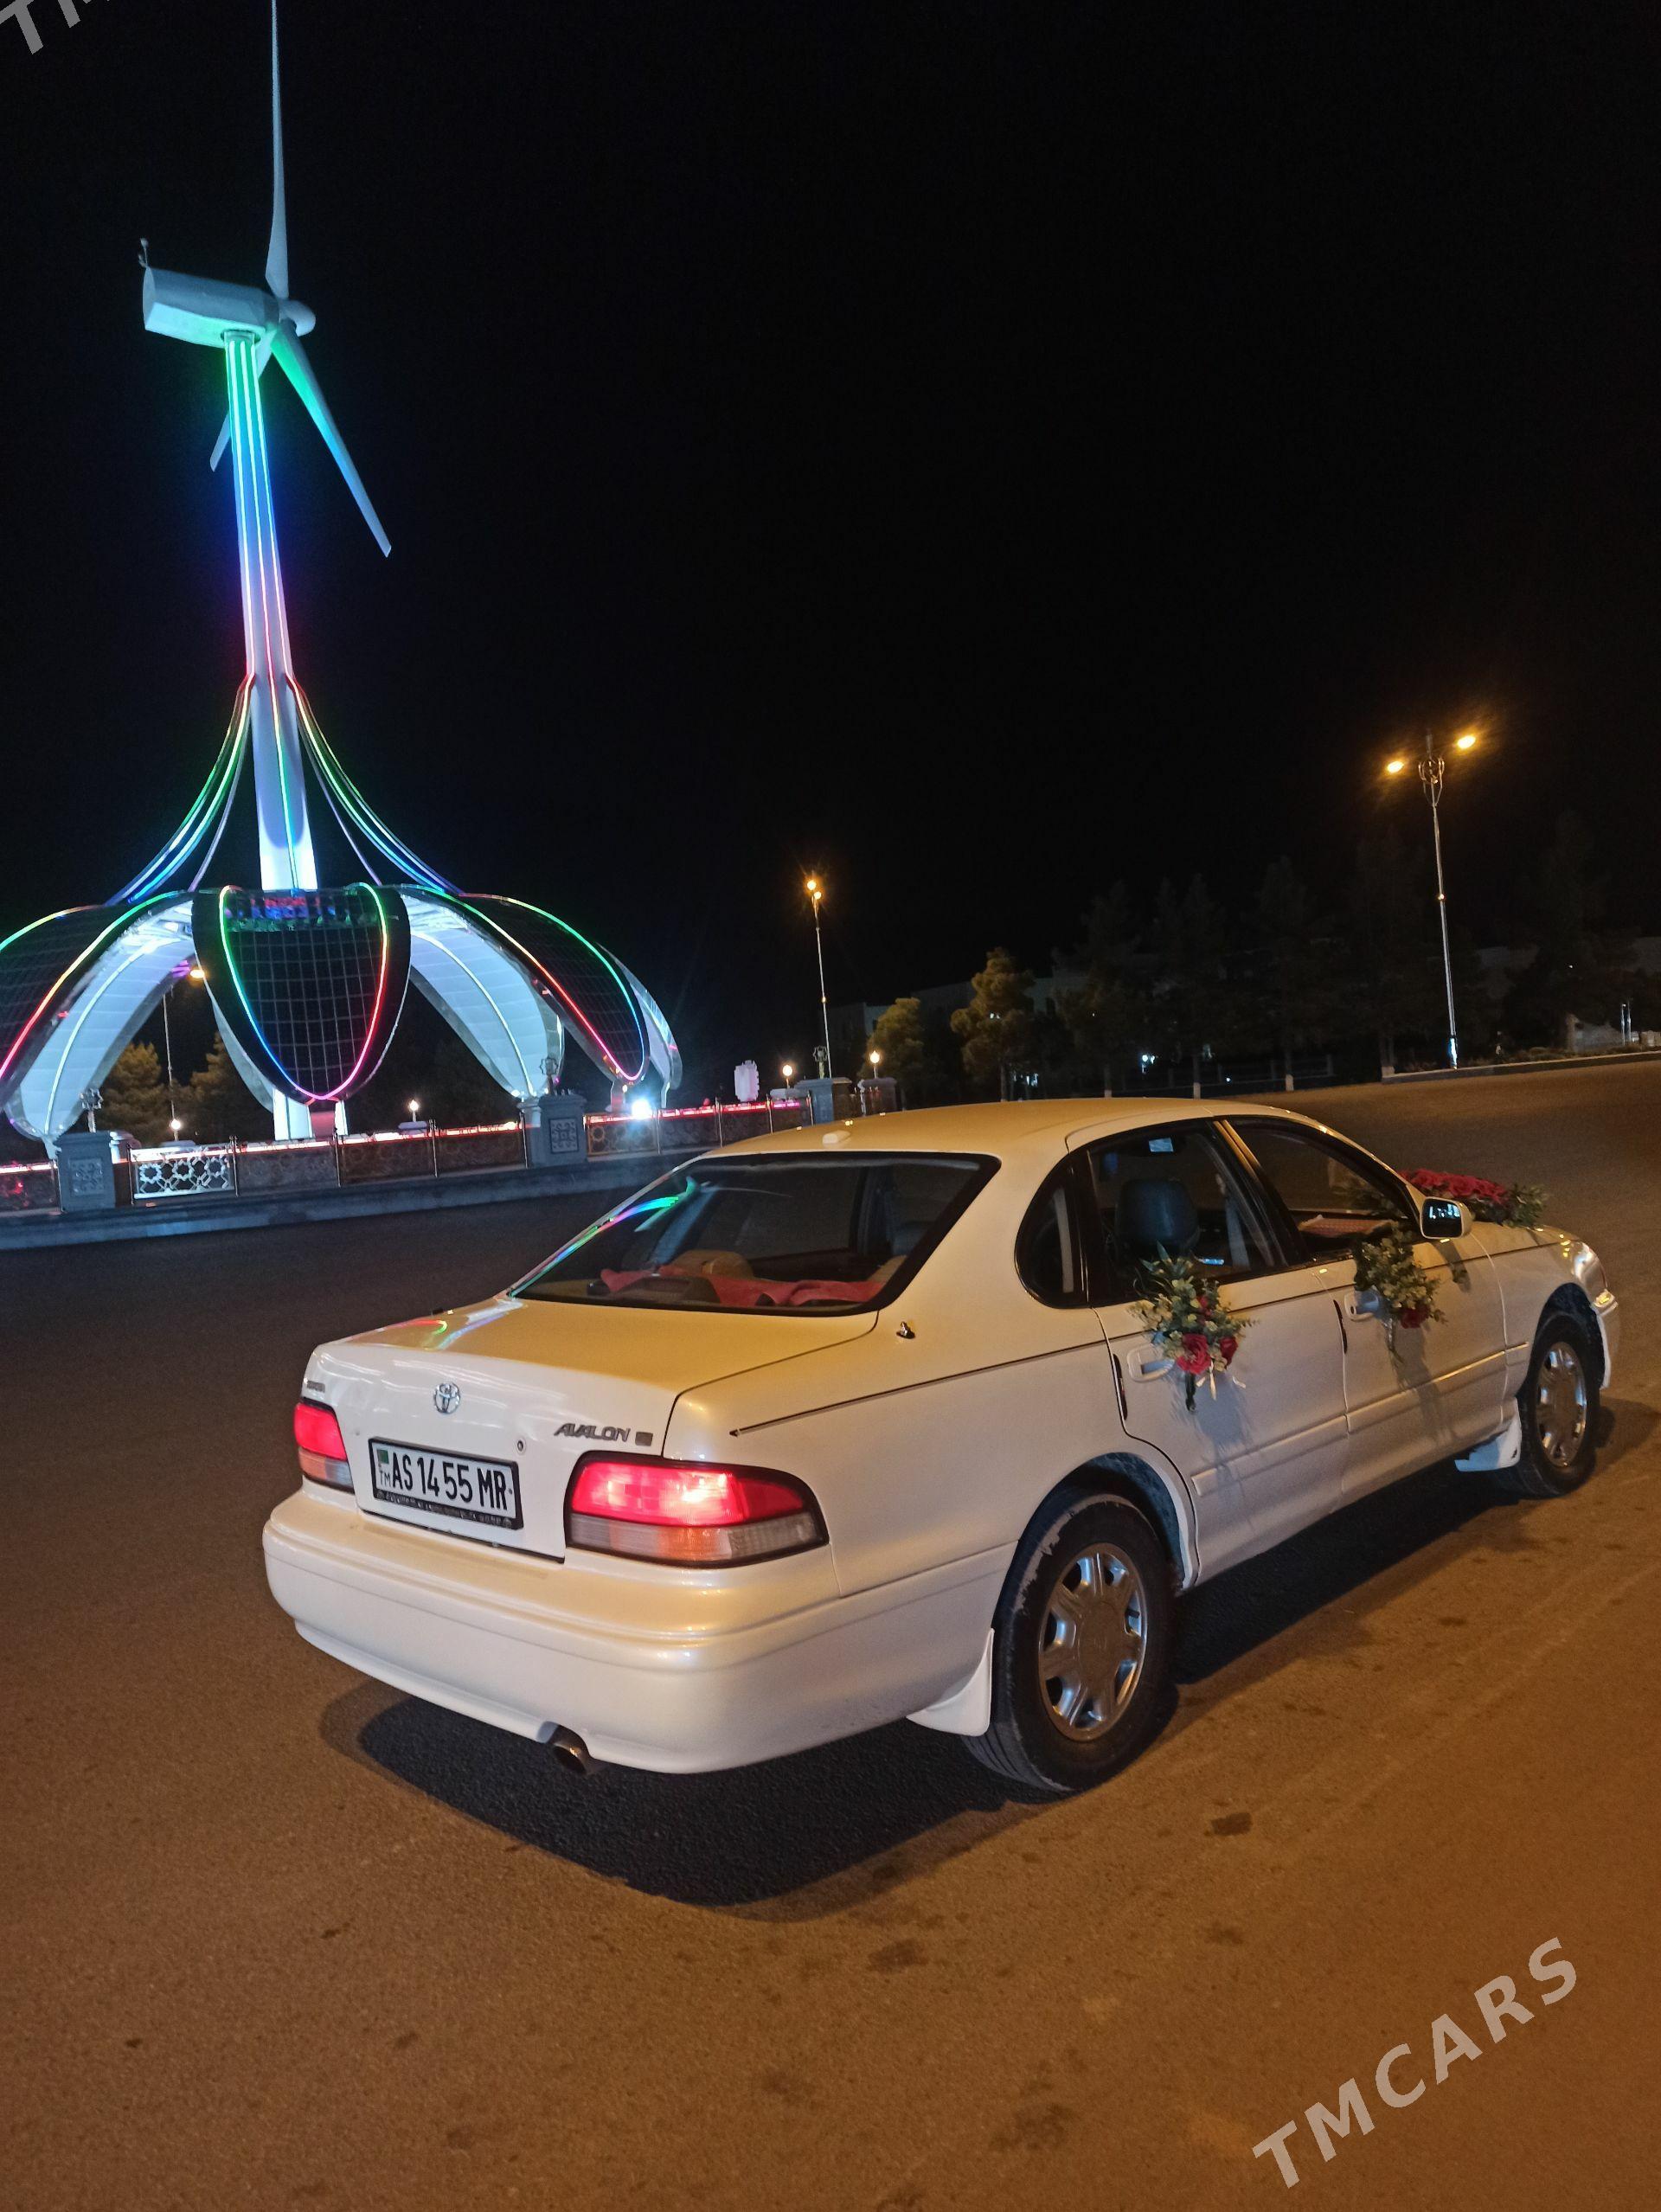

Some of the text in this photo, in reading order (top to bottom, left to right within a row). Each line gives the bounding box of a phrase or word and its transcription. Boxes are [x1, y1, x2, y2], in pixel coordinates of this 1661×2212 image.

[554, 1423, 631, 1442] AVALON
[379, 1469, 391, 1487] TM
[392, 1452, 414, 1491] AS
[417, 1456, 473, 1504] 1455
[477, 1467, 508, 1510] MR
